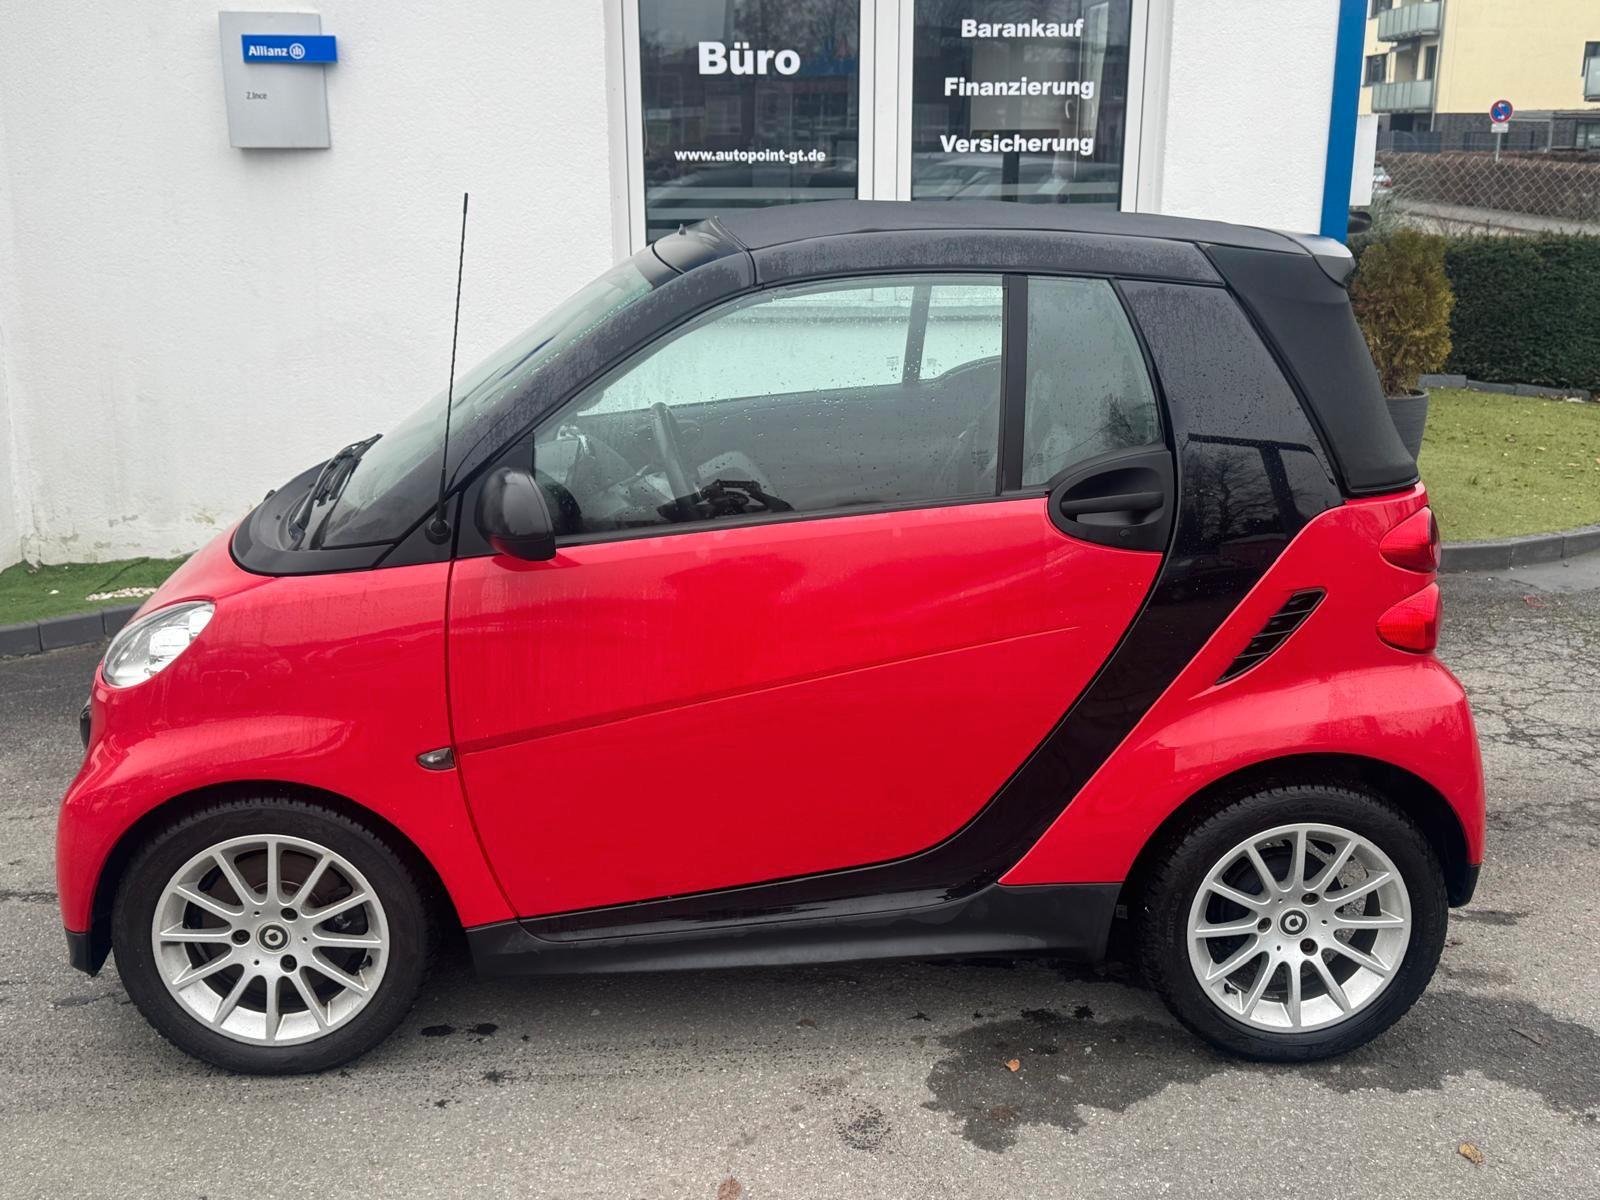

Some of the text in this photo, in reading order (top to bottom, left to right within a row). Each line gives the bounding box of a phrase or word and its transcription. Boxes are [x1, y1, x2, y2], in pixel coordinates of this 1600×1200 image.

[961, 18, 1085, 38] Barankauf
[248, 45, 288, 56] Allianz
[698, 41, 801, 75] Büro
[944, 77, 1095, 99] Finanzierung
[939, 135, 1095, 155] Versicherung
[674, 148, 826, 164] www.autopoint-gt.de
